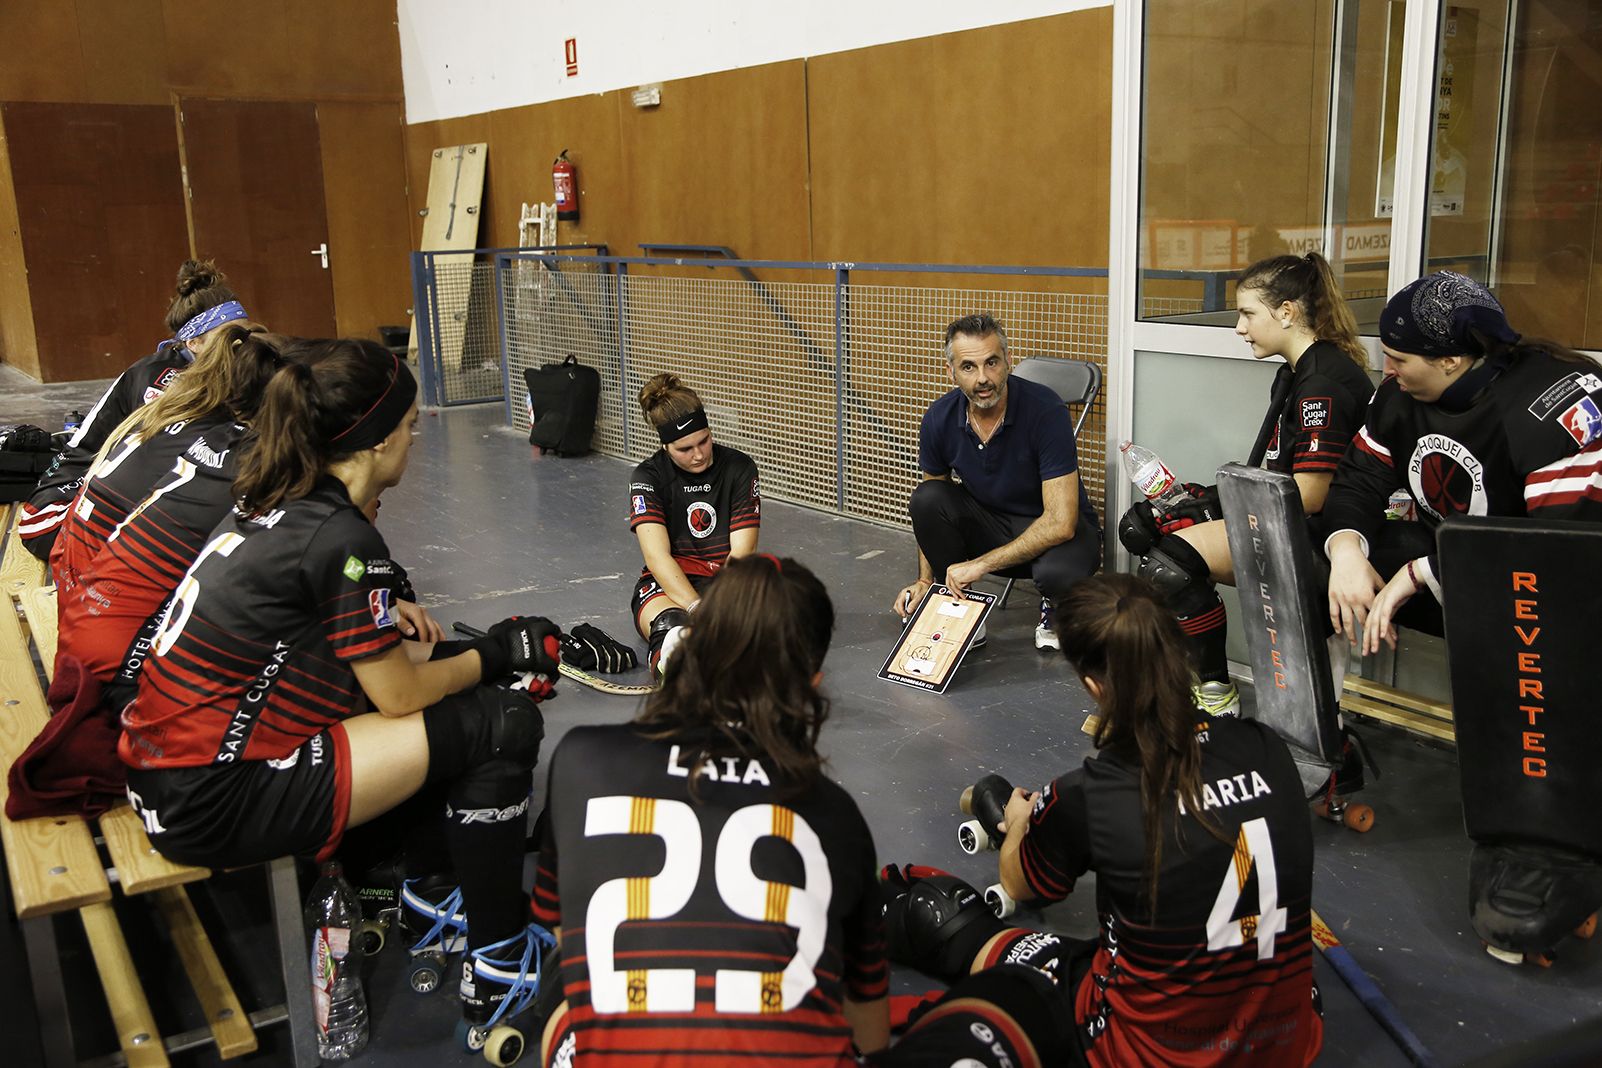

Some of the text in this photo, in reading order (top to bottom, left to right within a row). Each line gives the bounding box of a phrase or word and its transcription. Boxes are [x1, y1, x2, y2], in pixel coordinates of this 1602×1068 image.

[1302, 401, 1322, 411] Sant
[1303, 410, 1327, 420] Cugat
[1420, 437, 1462, 458] HOQUEI
[1462, 455, 1483, 493] CLUB
[1247, 514, 1287, 690] REVERTEC
[217, 710, 252, 763] SANT
[246, 640, 290, 703] CUGAT
[1512, 571, 1548, 778] REVERTEC
[310, 733, 324, 766] TUG
[667, 745, 770, 786] LAIA
[584, 795, 833, 1015] 29
[1207, 816, 1288, 960] 4
[462, 961, 474, 983] 6
